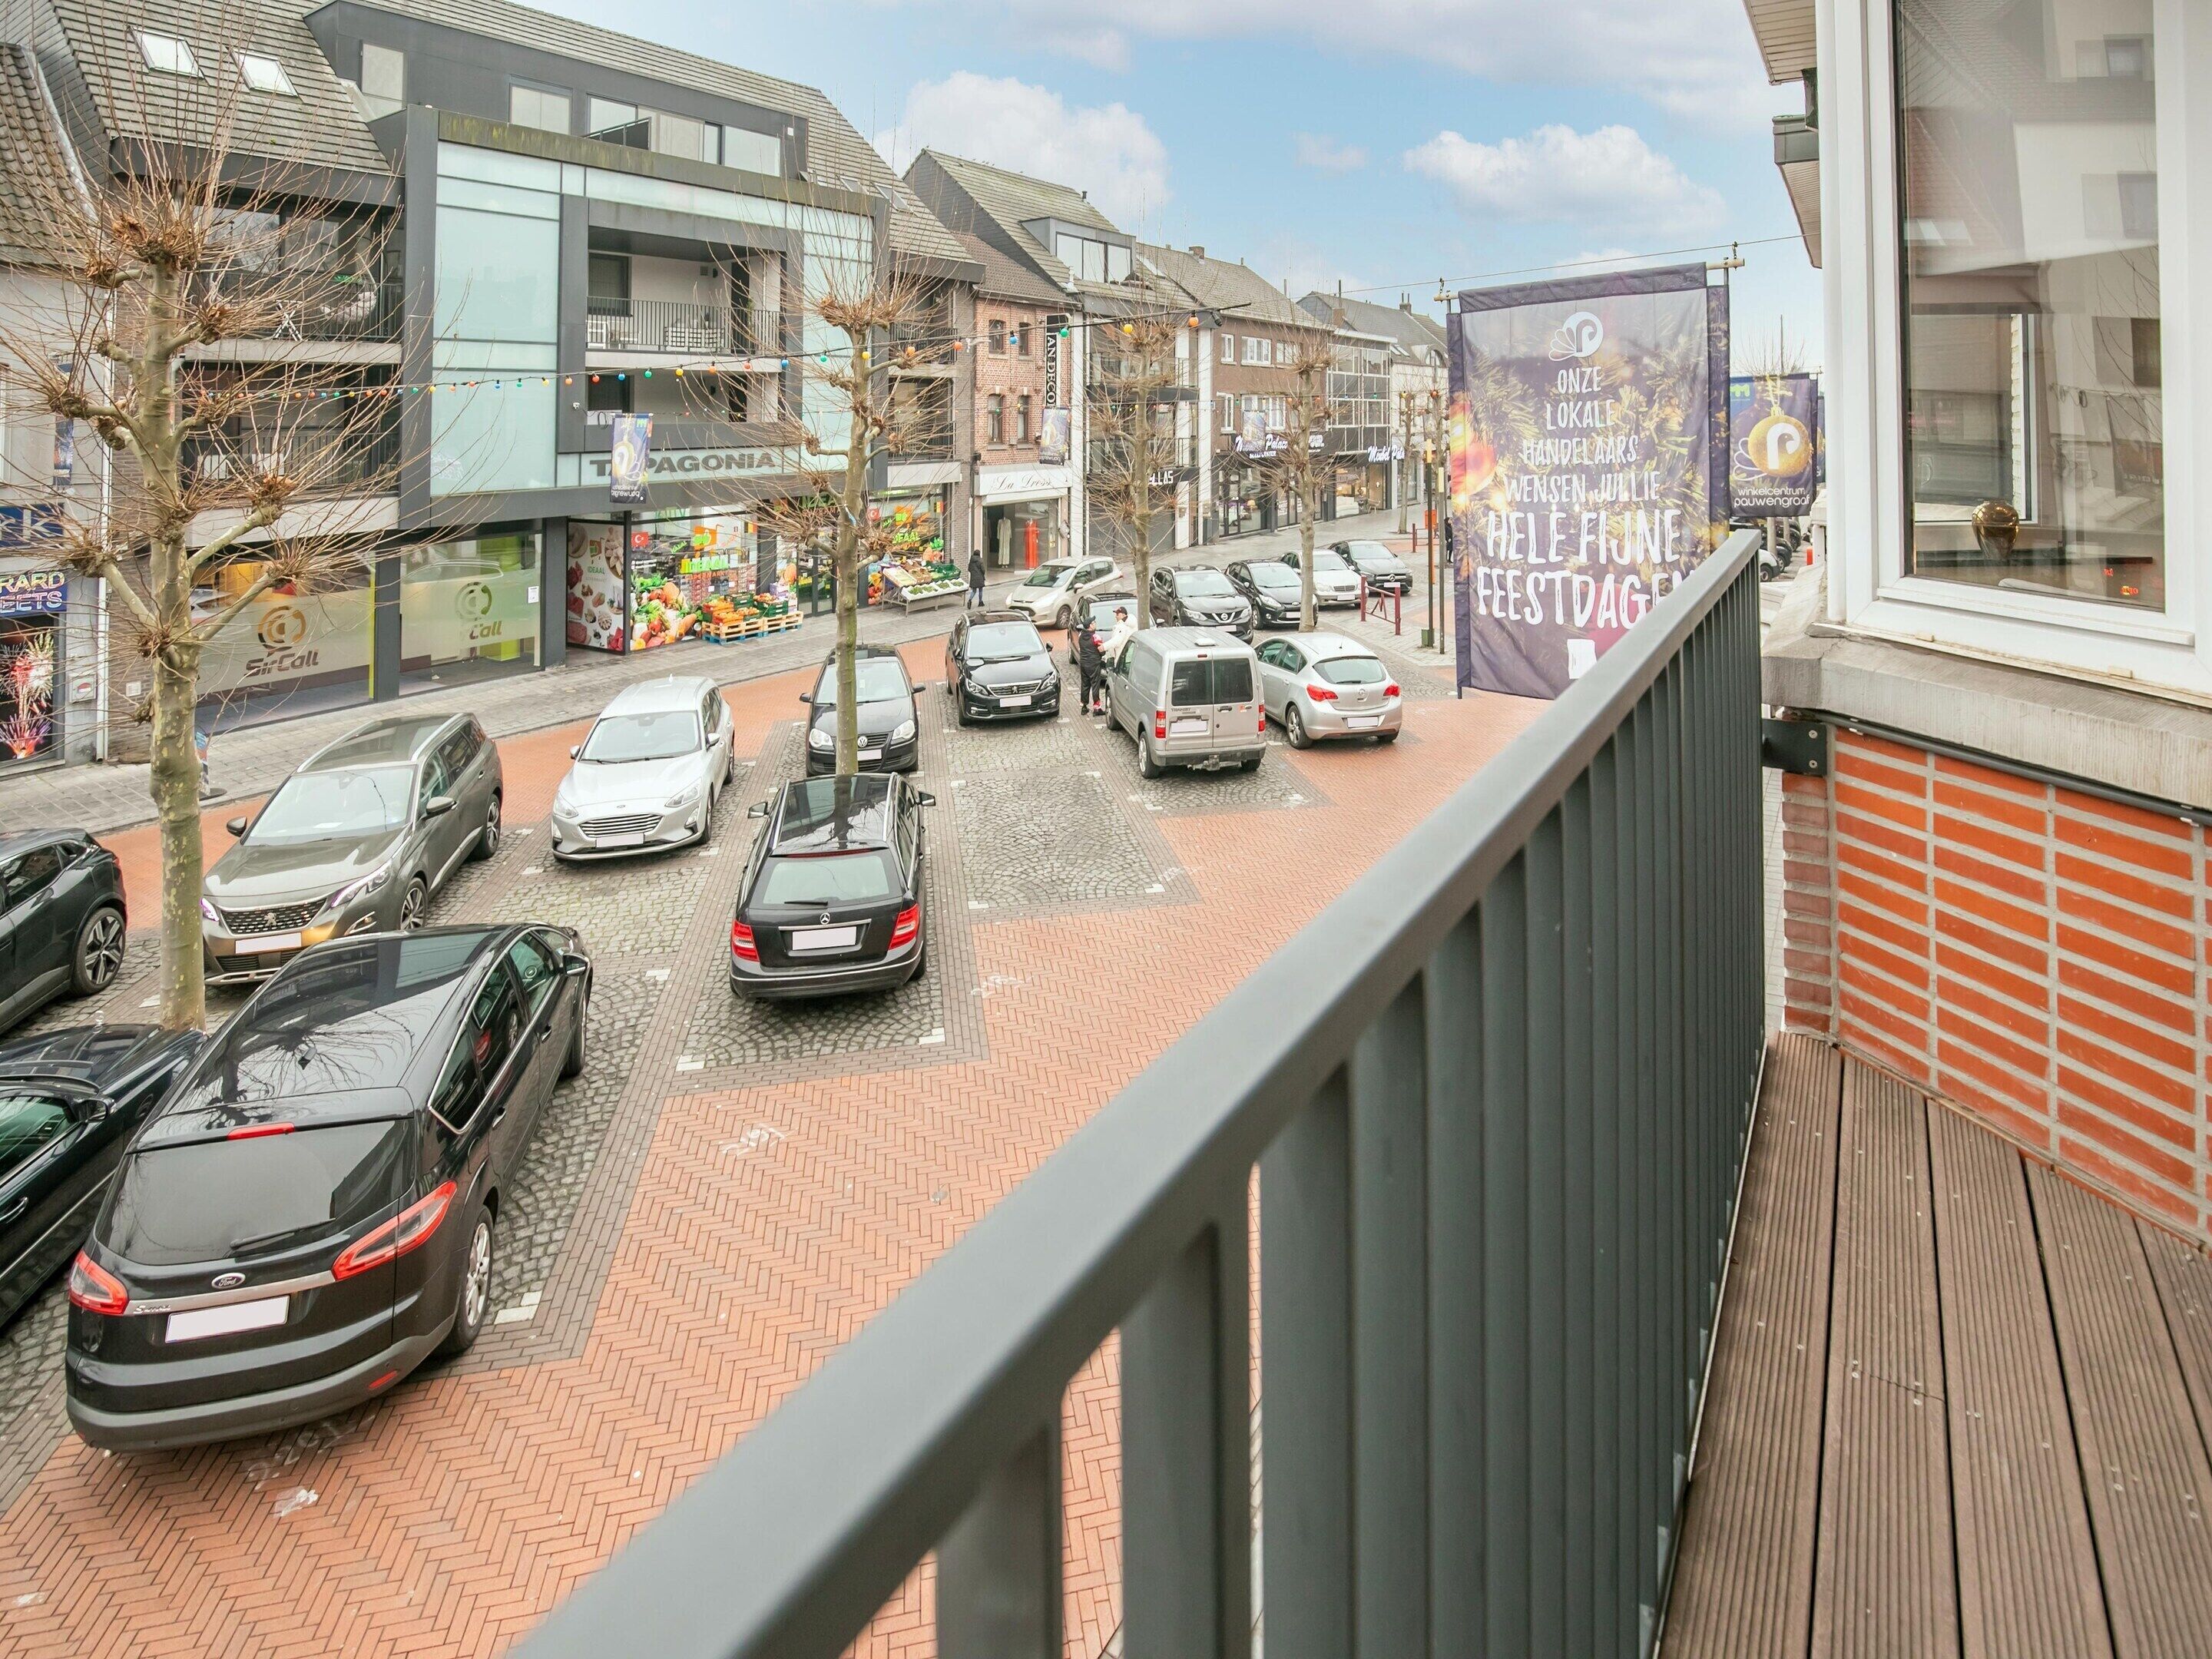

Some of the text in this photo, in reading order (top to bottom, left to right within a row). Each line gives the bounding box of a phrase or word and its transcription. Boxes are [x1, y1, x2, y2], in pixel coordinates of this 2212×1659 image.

[1557, 366, 1602, 394] ONZE
[1545, 399, 1616, 430] LOKALE
[1522, 435, 1640, 465] HANDELAARS
[589, 452, 776, 477] TPAGONIA
[993, 473, 1052, 491] La Dress
[1503, 471, 1661, 504] WENSEN JULLIE
[1737, 486, 1806, 496] winkelcentrum
[1734, 495, 1810, 508] pauwengraaf
[1487, 508, 1682, 565] HELE FIJNE
[1476, 565, 1696, 630] FEESTDAGE
[243, 650, 320, 678] SirCall
